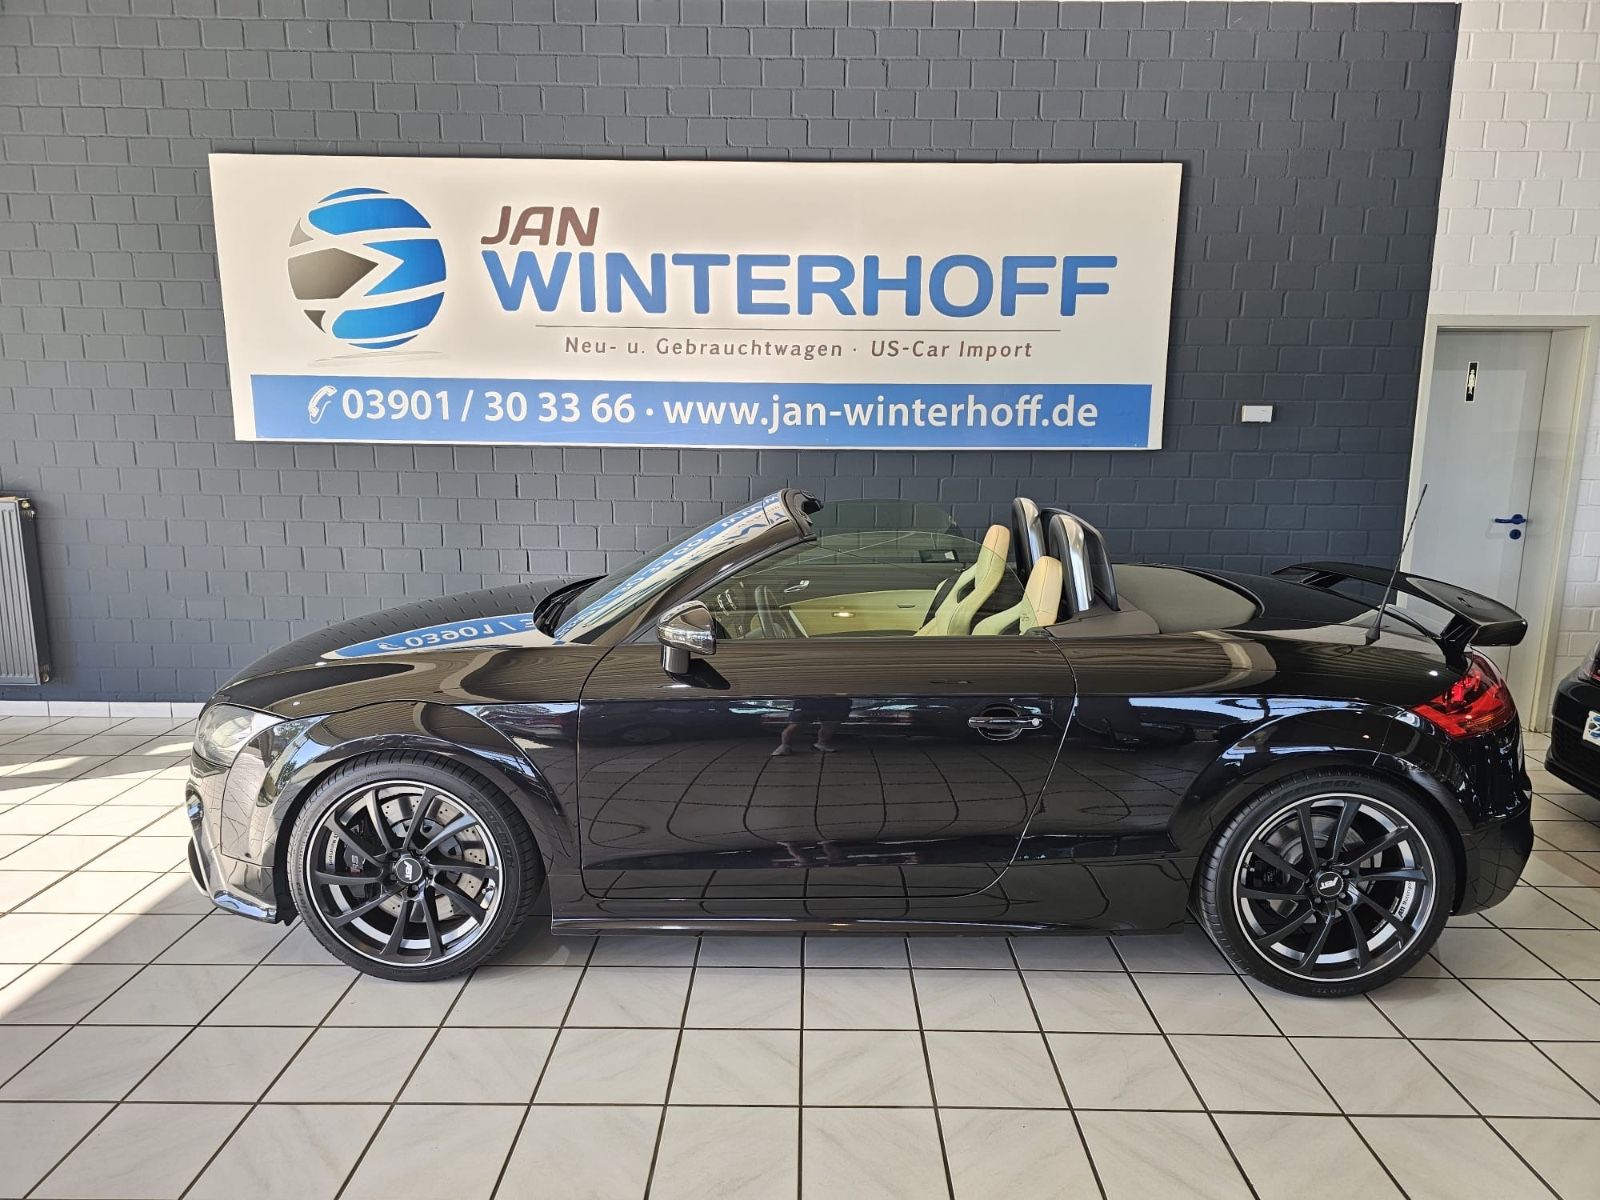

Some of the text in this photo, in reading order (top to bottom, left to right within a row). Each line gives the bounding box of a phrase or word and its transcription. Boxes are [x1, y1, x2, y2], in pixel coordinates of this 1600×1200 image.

[480, 205, 600, 247] JAN
[481, 250, 1118, 317] WINTERHOFF
[565, 336, 1033, 362] Neu- u. Gebrauchtwagen US-Car Import
[342, 388, 1099, 435] 03901 / 30 33 66 www.jan-winterhoff.de
